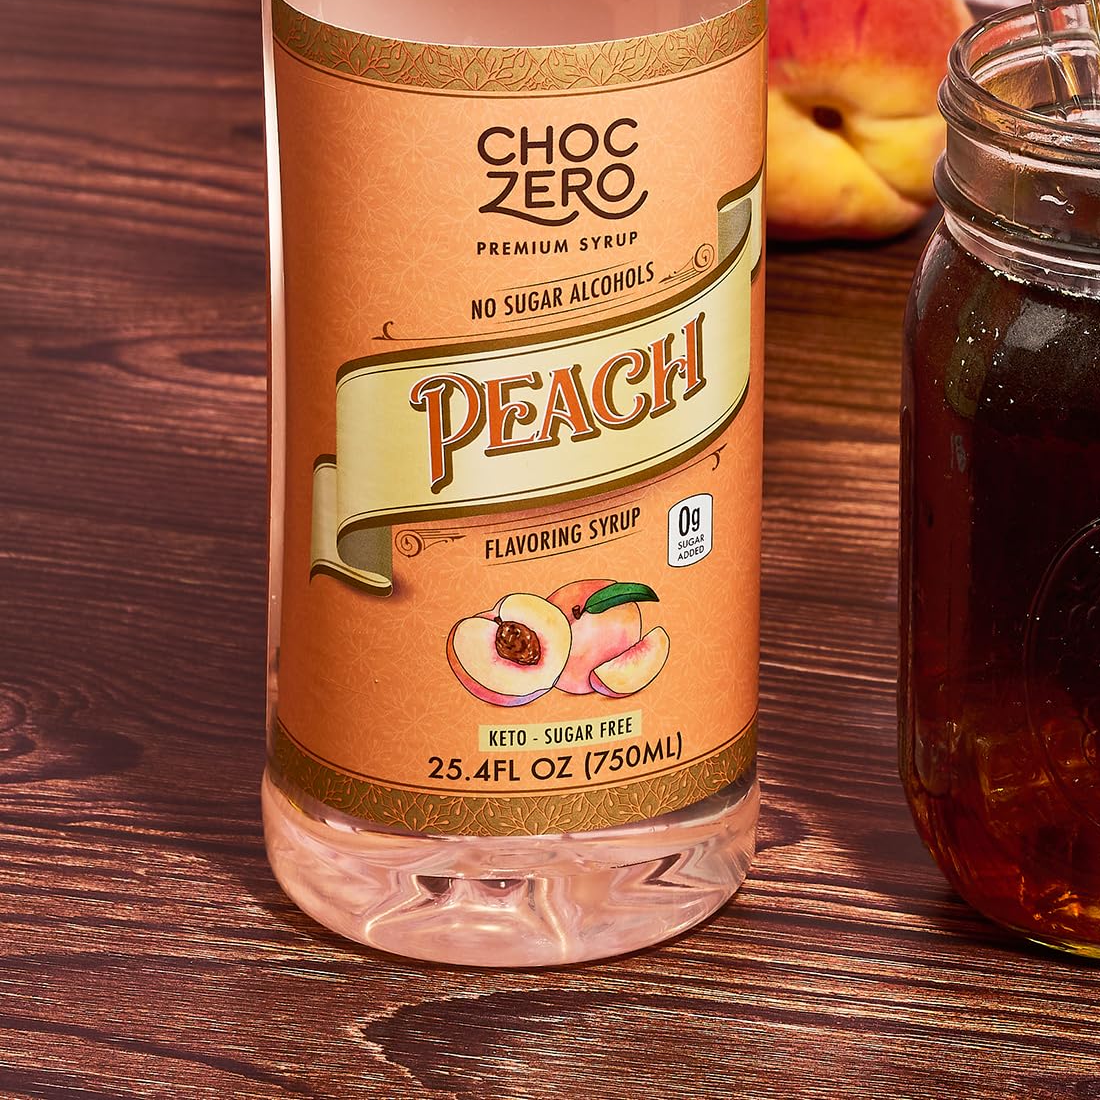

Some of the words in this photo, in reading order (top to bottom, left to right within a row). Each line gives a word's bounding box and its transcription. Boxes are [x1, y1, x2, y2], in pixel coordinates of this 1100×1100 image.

[477, 117, 639, 167] CHOC
[479, 162, 649, 227] ZERO
[476, 238, 570, 256] PREMIUM
[579, 231, 639, 252] SYRUP
[470, 297, 497, 321] NO
[503, 287, 563, 316] SUGAR
[569, 261, 655, 304] ALCOHOLS
[409, 311, 707, 494] PEACH
[484, 527, 582, 560] FLAVORING
[589, 506, 642, 540] SYRUP
[677, 533, 705, 551] SUGAR
[678, 504, 701, 537] 0g
[677, 544, 705, 562] ADDED
[427, 756, 521, 783] 25.4FL
[530, 755, 573, 781] OZ
[584, 731, 683, 781] (750ML)
[488, 729, 527, 748] KETO
[544, 723, 594, 746] SUGAR
[599, 716, 633, 738] FREE
